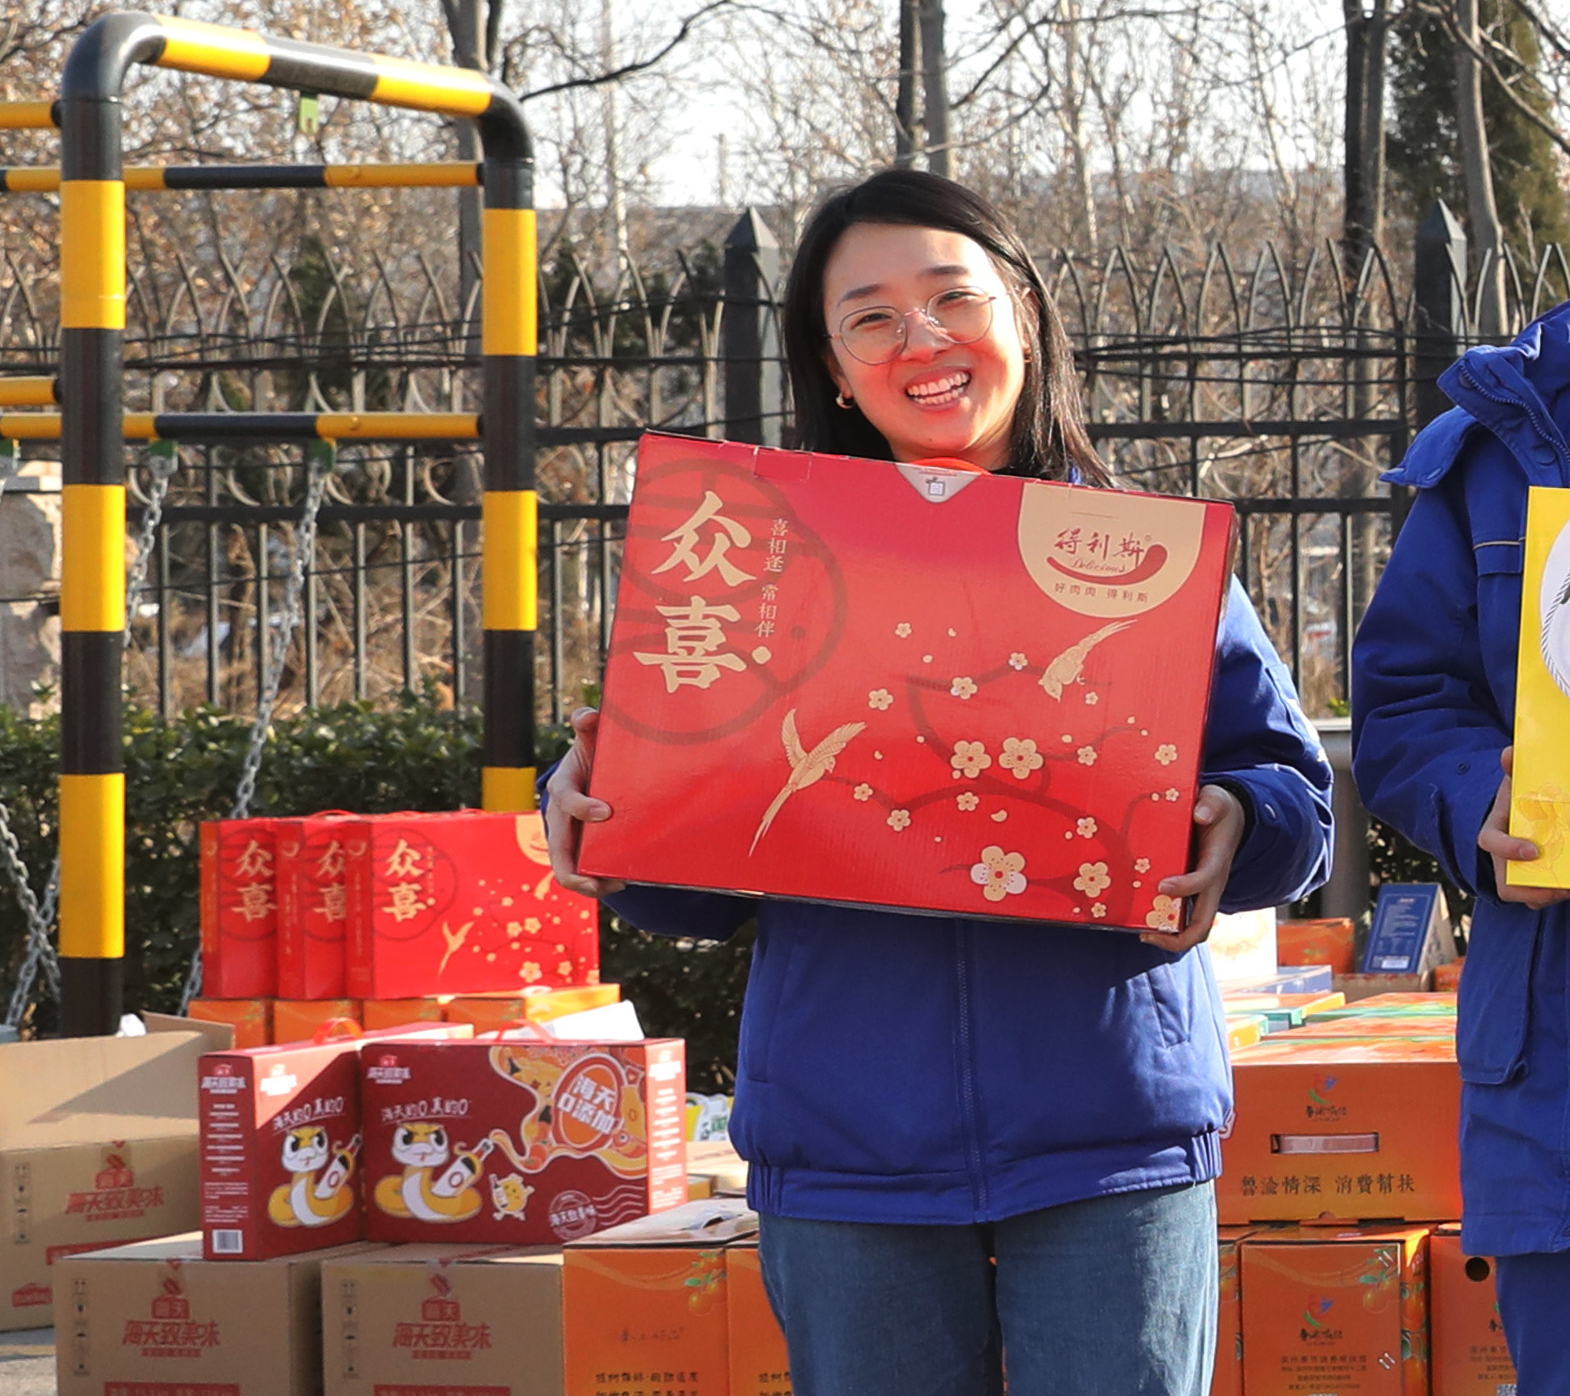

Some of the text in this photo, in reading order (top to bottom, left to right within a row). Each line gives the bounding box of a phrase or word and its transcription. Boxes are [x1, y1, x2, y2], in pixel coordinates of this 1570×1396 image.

[1054, 527, 1145, 563] 得利斯
[755, 518, 789, 638] 喜相逢 常相伴
[1053, 582, 1149, 603] 好肉肉 得利斯
